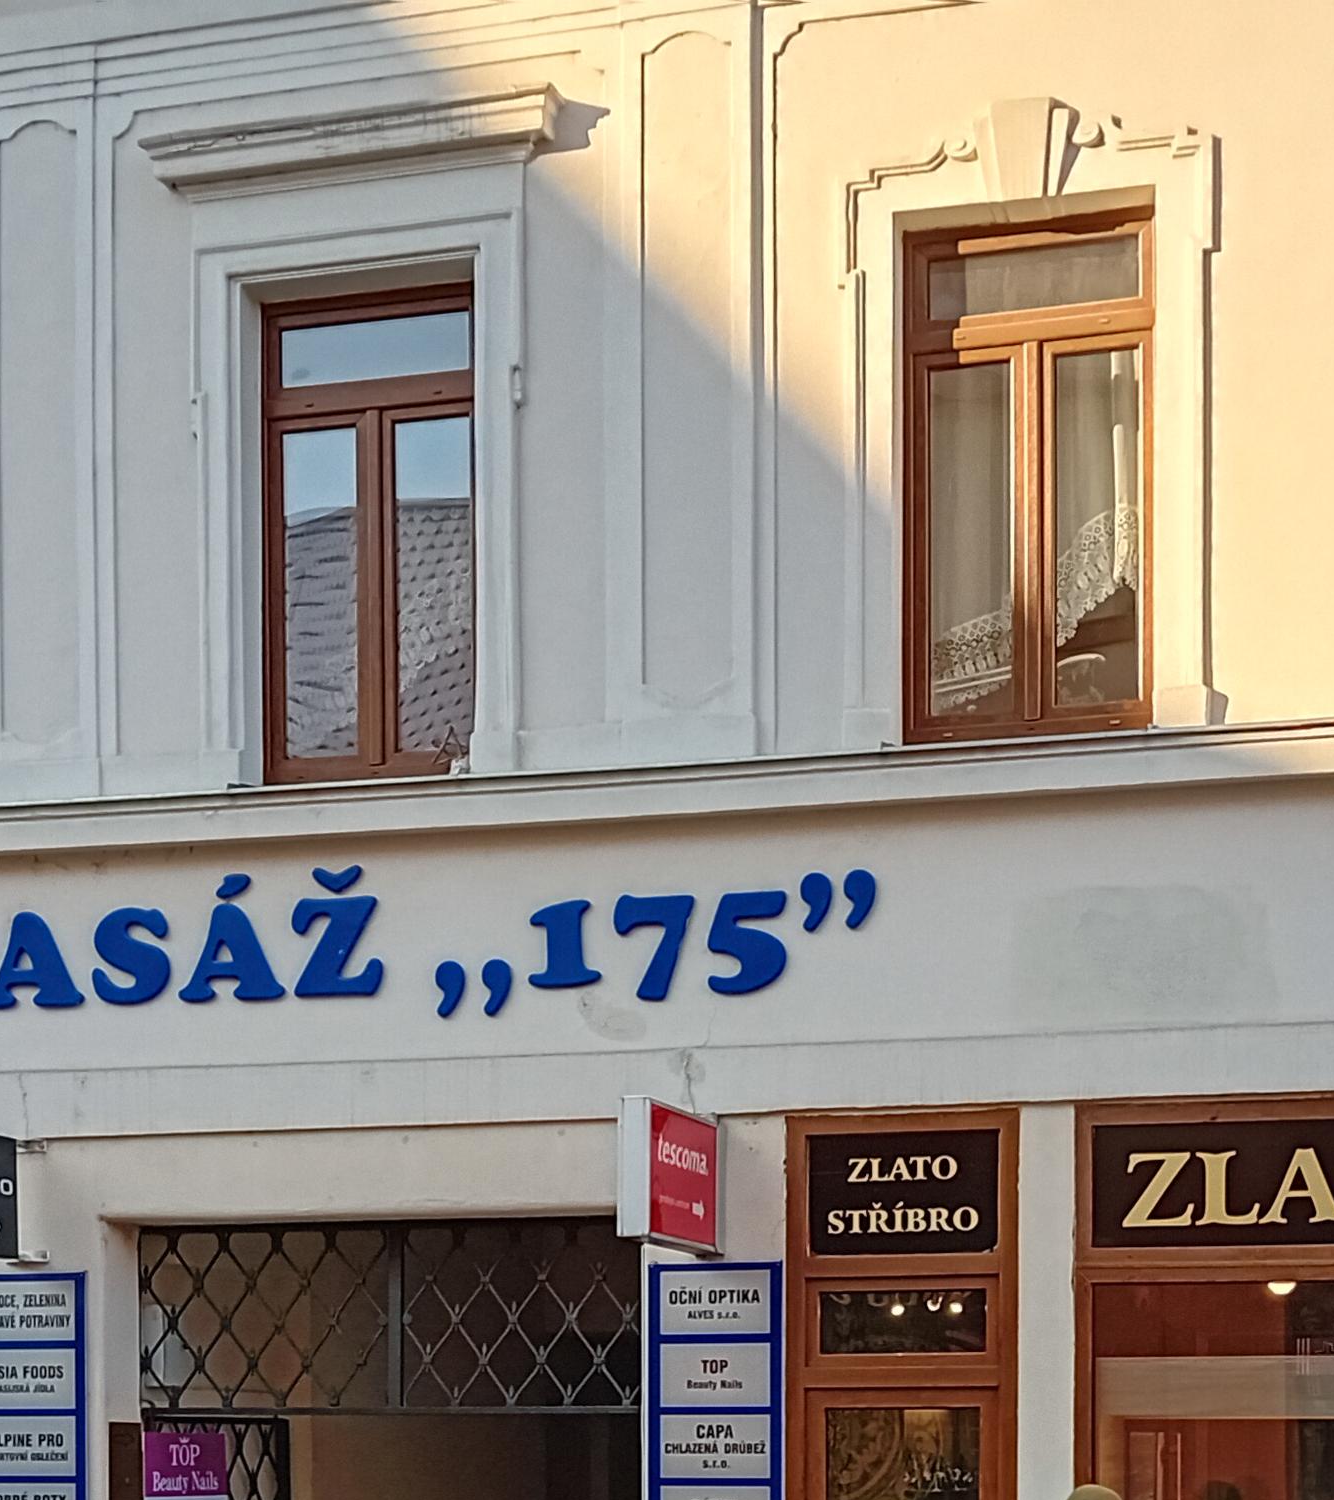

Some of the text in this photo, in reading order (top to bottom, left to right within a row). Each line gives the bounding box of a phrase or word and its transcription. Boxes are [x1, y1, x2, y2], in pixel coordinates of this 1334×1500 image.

[847, 1155, 958, 1183] ZLATO
[827, 1201, 979, 1235] STŘÍBRO
[23, 1293, 67, 1308] ZELENINA
[668, 1286, 761, 1305] OČNÍ OPTIKA
[19, 1314, 71, 1329] POTRAVINY
[23, 1365, 64, 1379] FOODS
[701, 1359, 729, 1374] TOP
[687, 1379, 743, 1391] Beauty Nails
[696, 1424, 734, 1439] CAPA
[38, 1433, 64, 1447] PRO
[664, 1440, 719, 1455] CHLAZENÁ
[169, 1443, 201, 1467] TOP
[702, 1459, 730, 1469] s.r.o.
[152, 1470, 219, 1494] Beauty Nails
